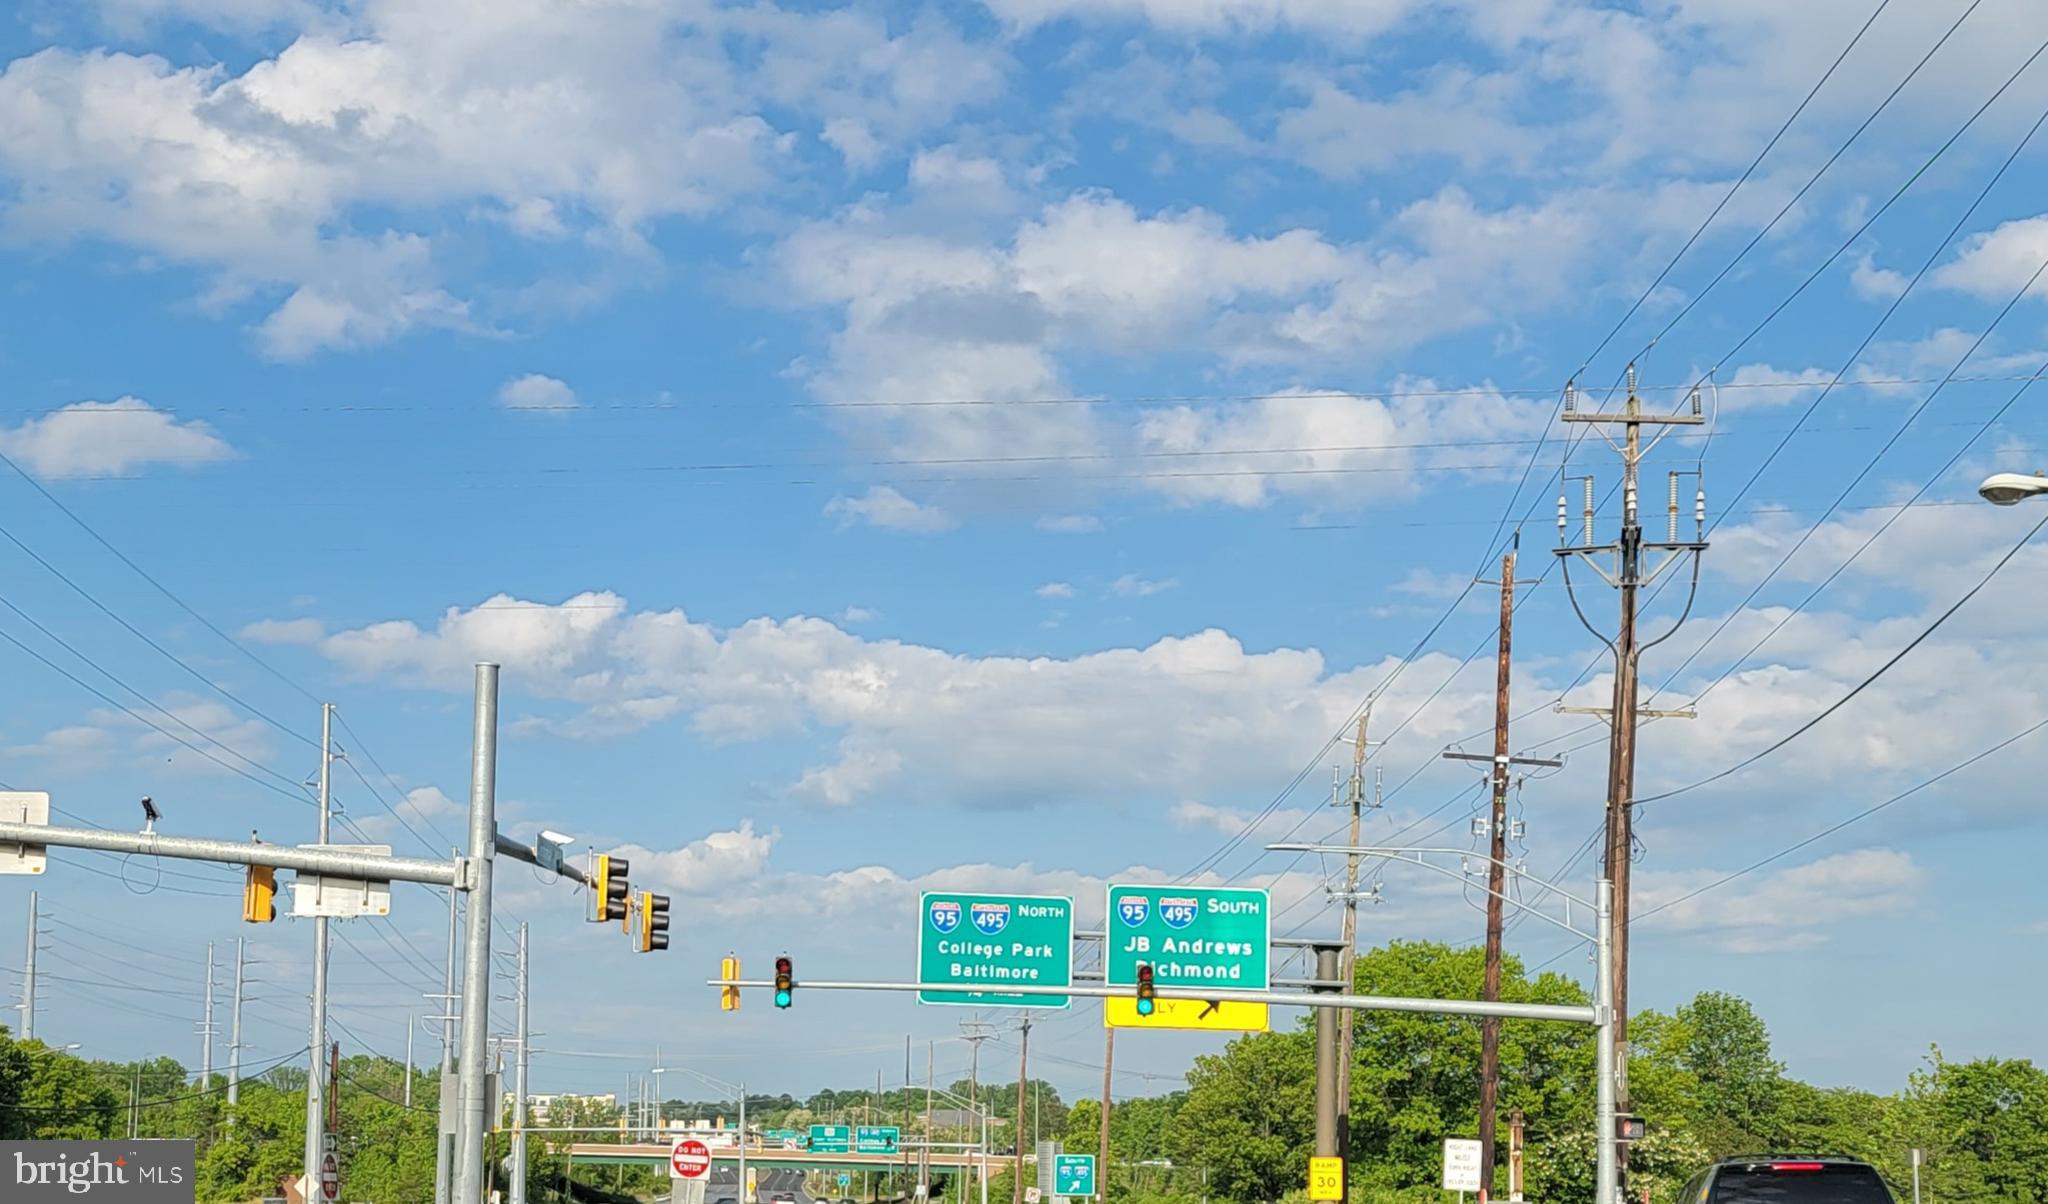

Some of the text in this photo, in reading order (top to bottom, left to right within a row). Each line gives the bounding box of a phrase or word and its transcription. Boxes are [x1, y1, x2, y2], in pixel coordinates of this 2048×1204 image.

[935, 911, 957, 927] 95
[976, 912, 1005, 928] 495
[1018, 904, 1064, 918] NORTH
[1122, 905, 1145, 920] 95
[1164, 906, 1193, 922] 495
[1207, 898, 1260, 914] SOUTH
[938, 940, 1053, 959] College Park
[1124, 936, 1253, 955] JB Andrews
[950, 963, 1039, 979] Baltimore
[691, 1147, 706, 1155] NOT
[679, 1163, 702, 1171] ENTER
[1317, 1176, 1336, 1188] 30
